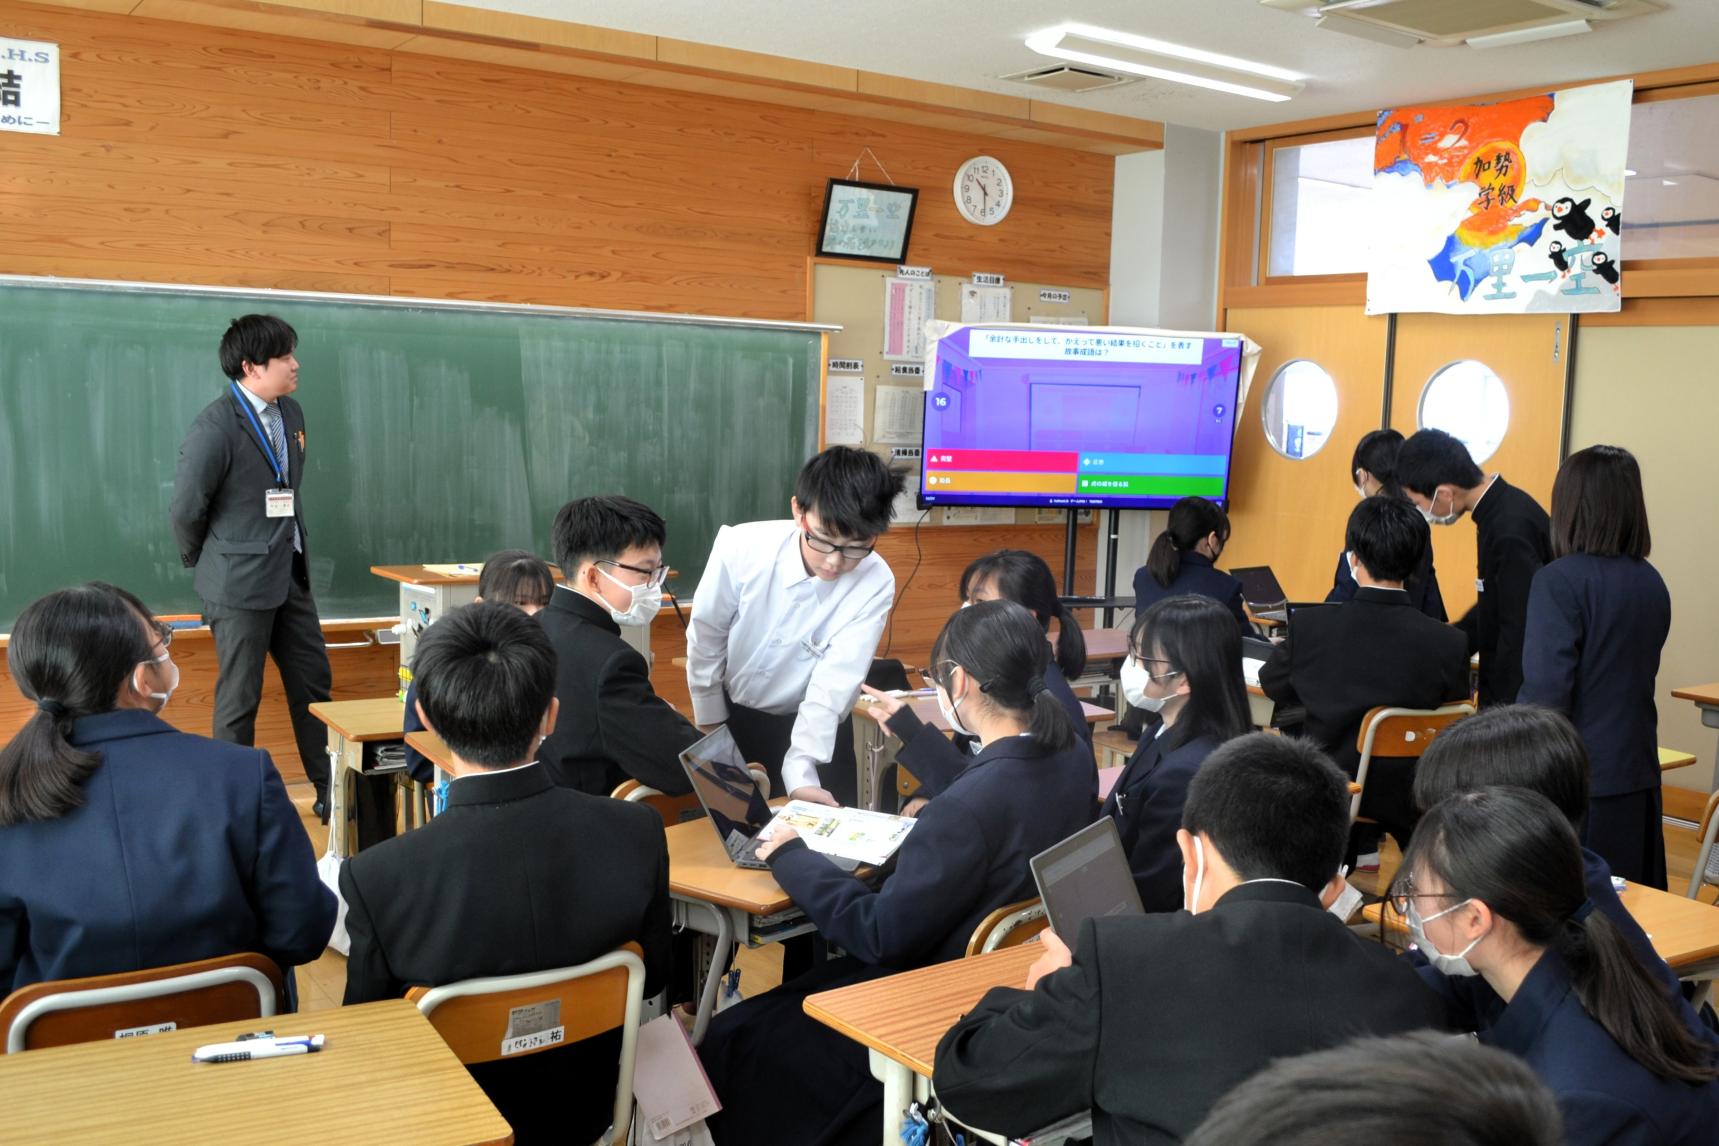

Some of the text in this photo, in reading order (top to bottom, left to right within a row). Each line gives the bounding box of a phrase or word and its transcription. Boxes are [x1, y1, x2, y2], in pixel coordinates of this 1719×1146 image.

[1474, 151, 1513, 180] 加勢
[1478, 183, 1518, 211] 学級
[831, 361, 860, 370] 時間割表
[935, 397, 946, 407] 16
